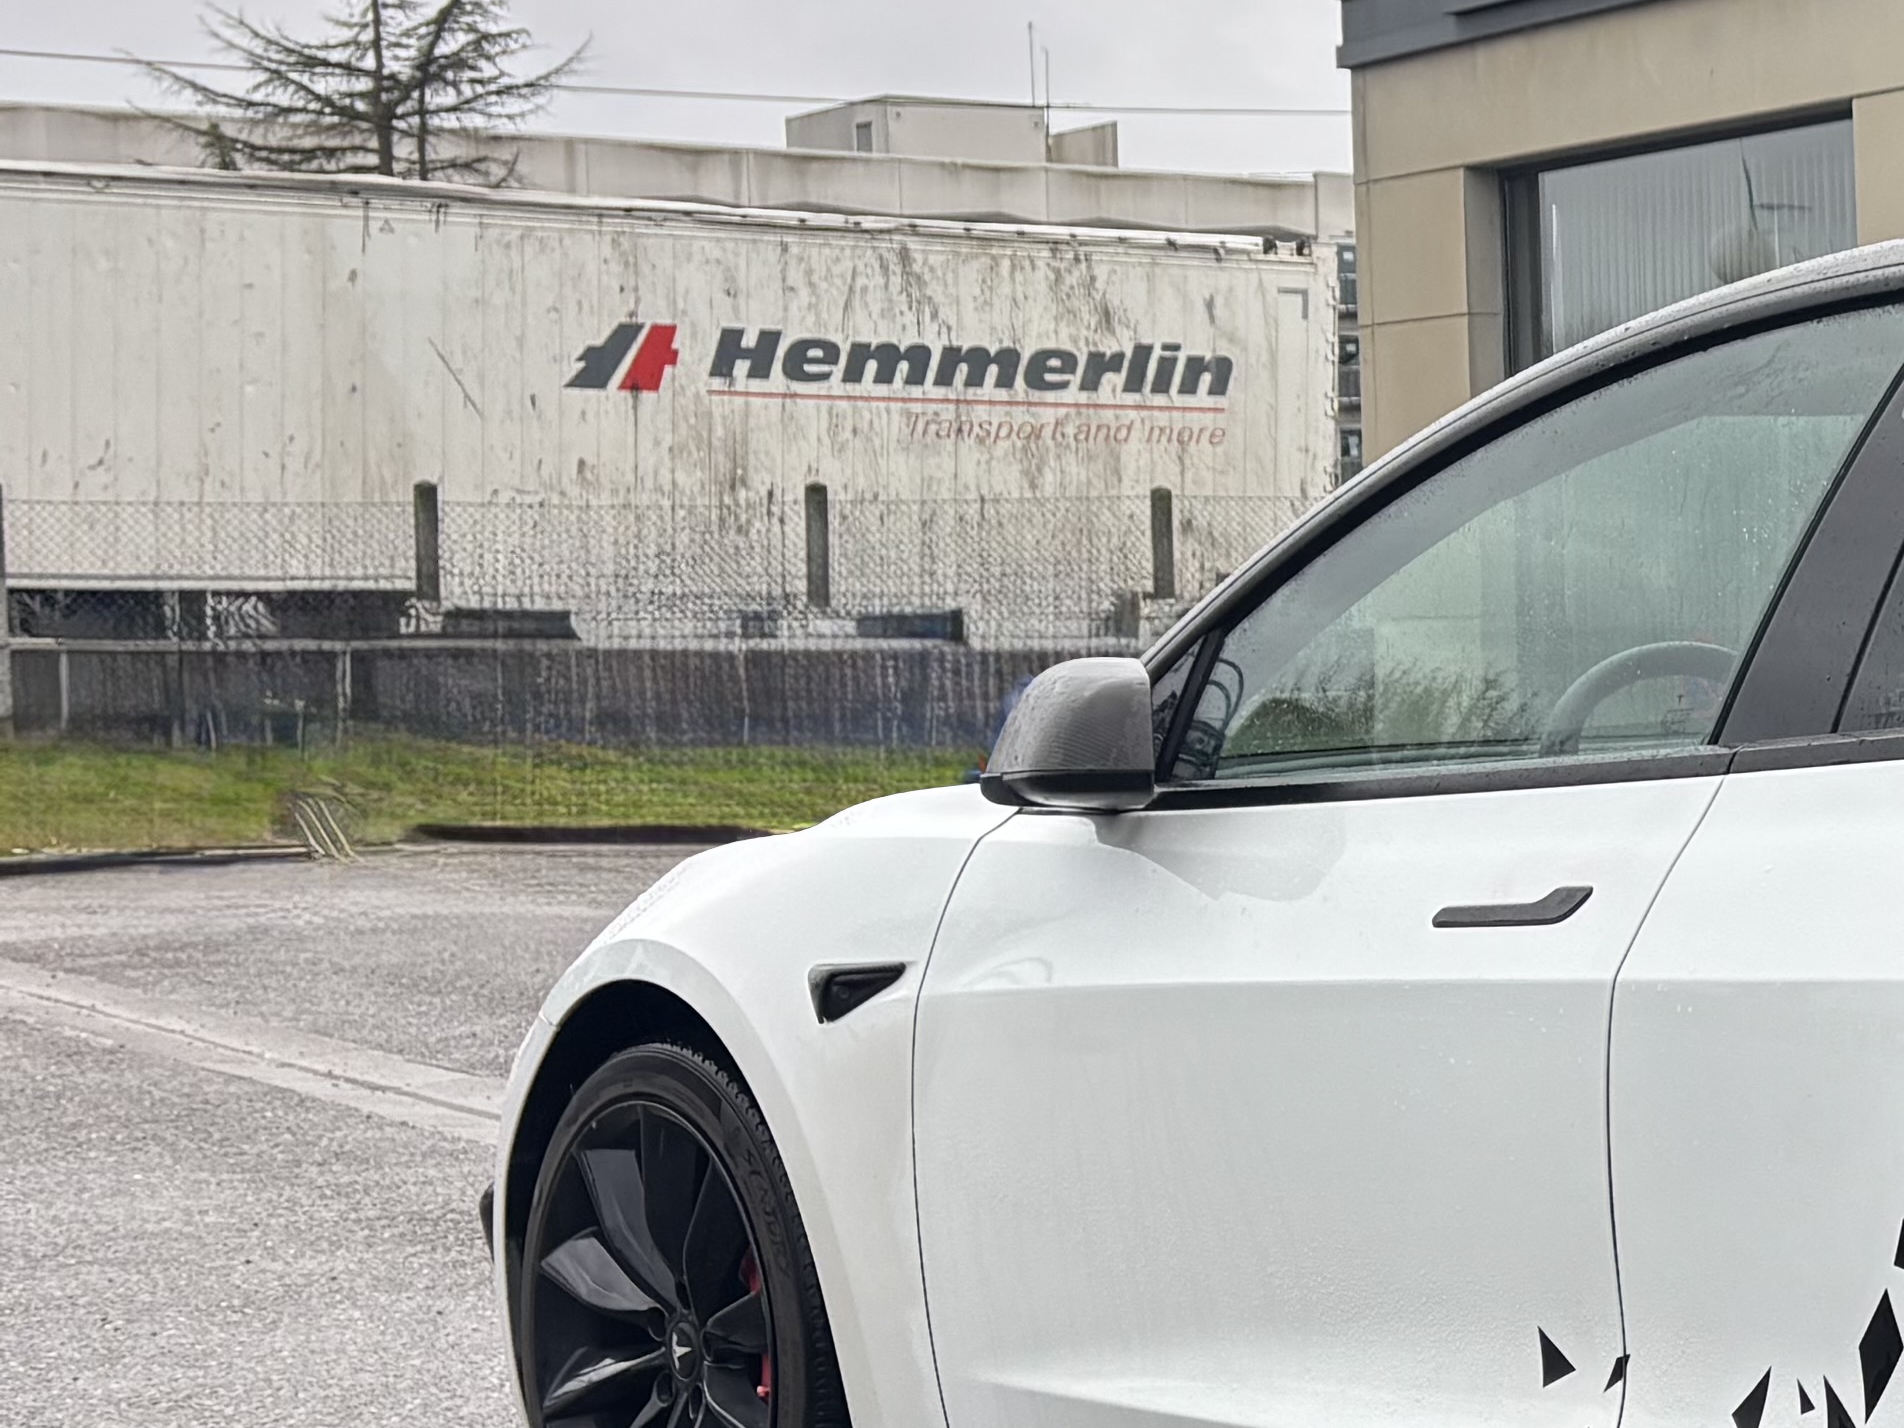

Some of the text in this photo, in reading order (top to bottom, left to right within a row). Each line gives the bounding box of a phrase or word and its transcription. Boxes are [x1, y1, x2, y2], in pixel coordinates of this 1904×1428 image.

[707, 326, 1235, 397] Hemmerlin
[906, 411, 1226, 447] Transport and more
